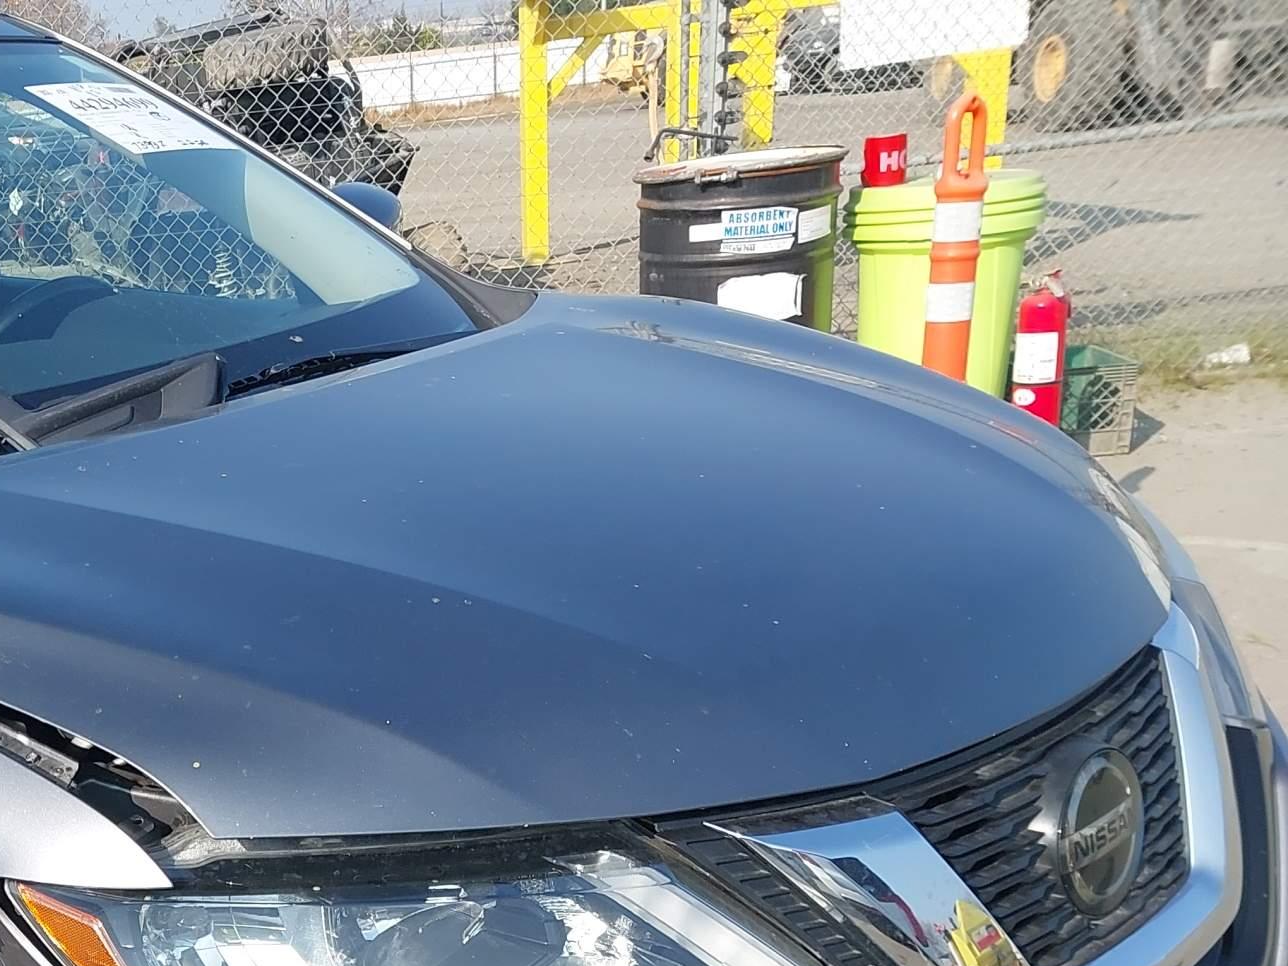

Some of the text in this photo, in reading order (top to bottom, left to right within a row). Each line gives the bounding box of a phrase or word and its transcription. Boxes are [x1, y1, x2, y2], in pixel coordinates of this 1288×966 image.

[728, 209, 793, 224] ABSORBENT
[724, 221, 794, 237] MATERIAL ONLY
